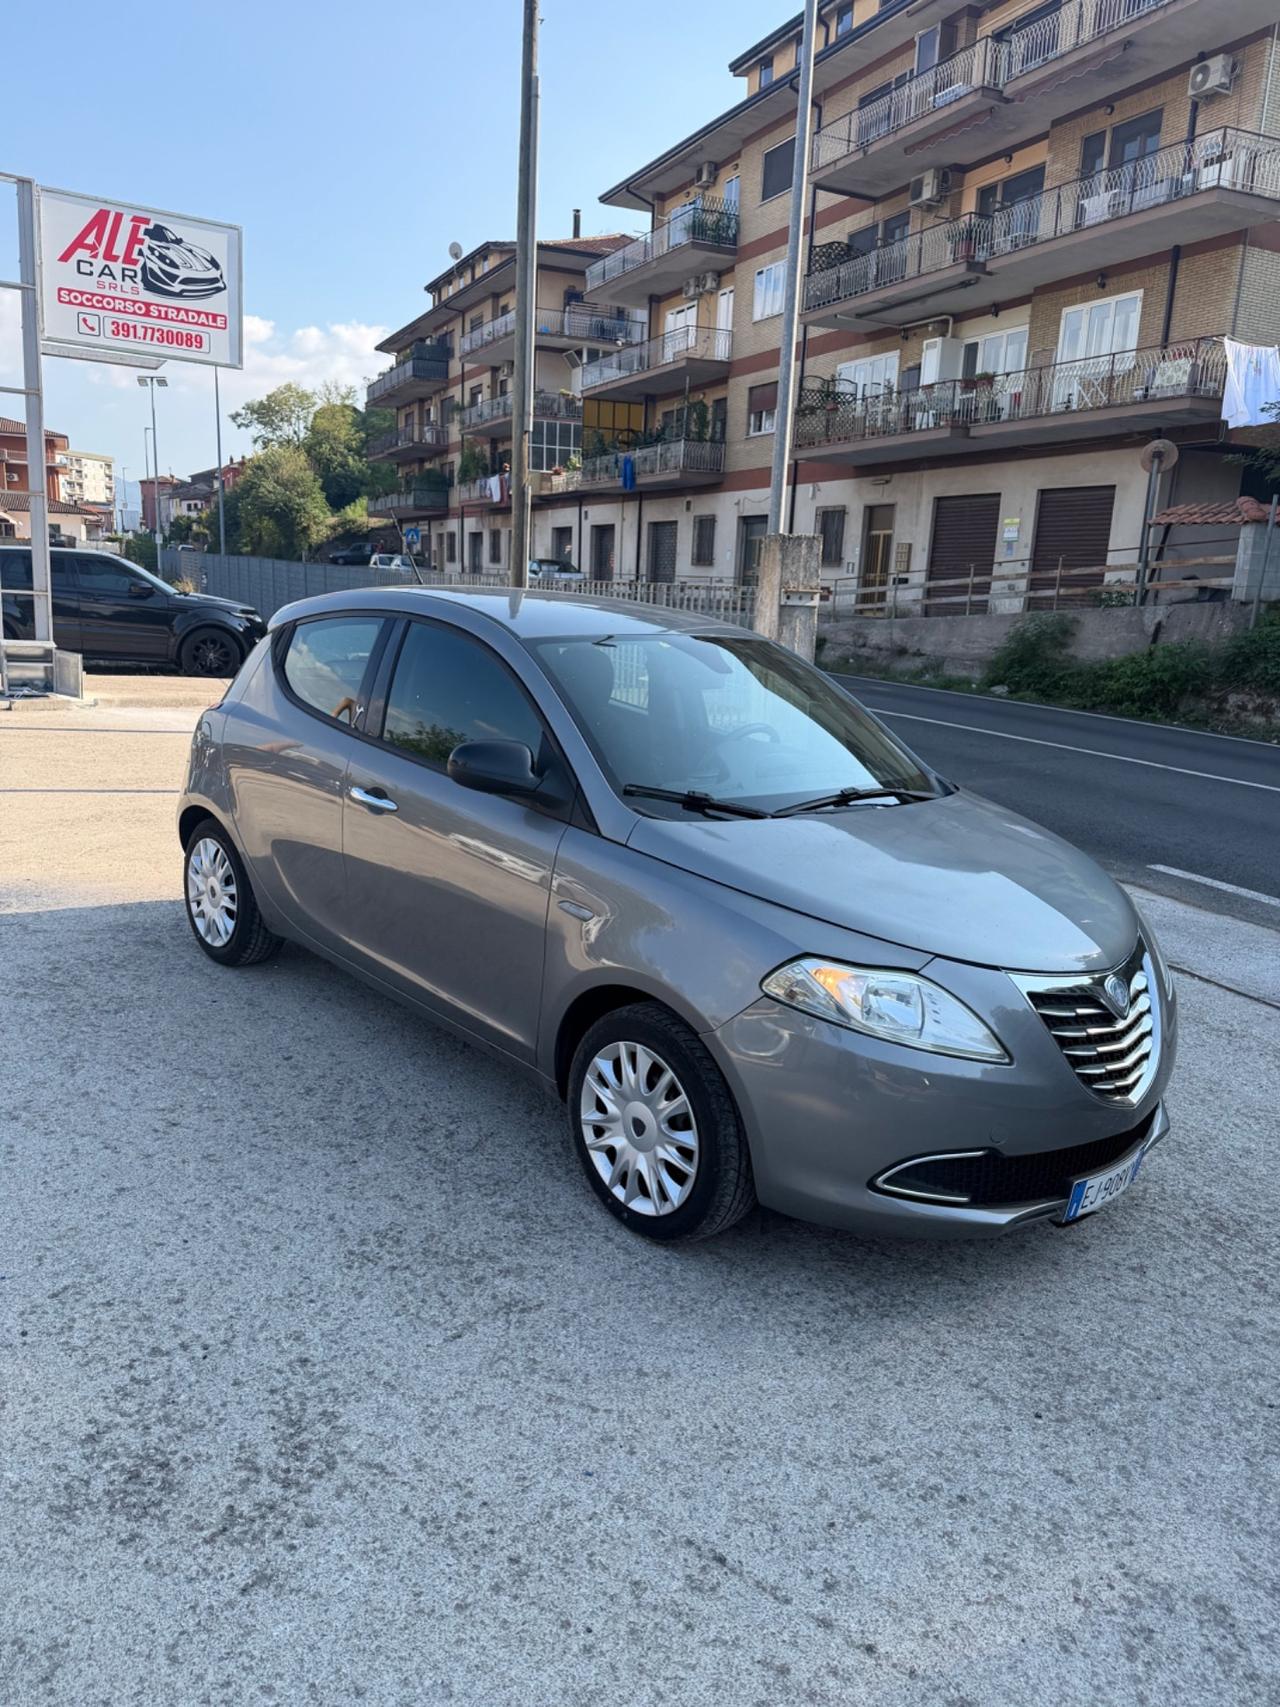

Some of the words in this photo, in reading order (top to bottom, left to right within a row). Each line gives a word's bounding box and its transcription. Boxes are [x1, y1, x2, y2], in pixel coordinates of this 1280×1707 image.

[57, 208, 151, 267] ALE
[76, 259, 138, 285] CAR
[96, 280, 140, 296] SRLS
[60, 290, 146, 314] SOCCORSO
[149, 306, 226, 328] STRADALE
[111, 320, 203, 349] 391.7730089
